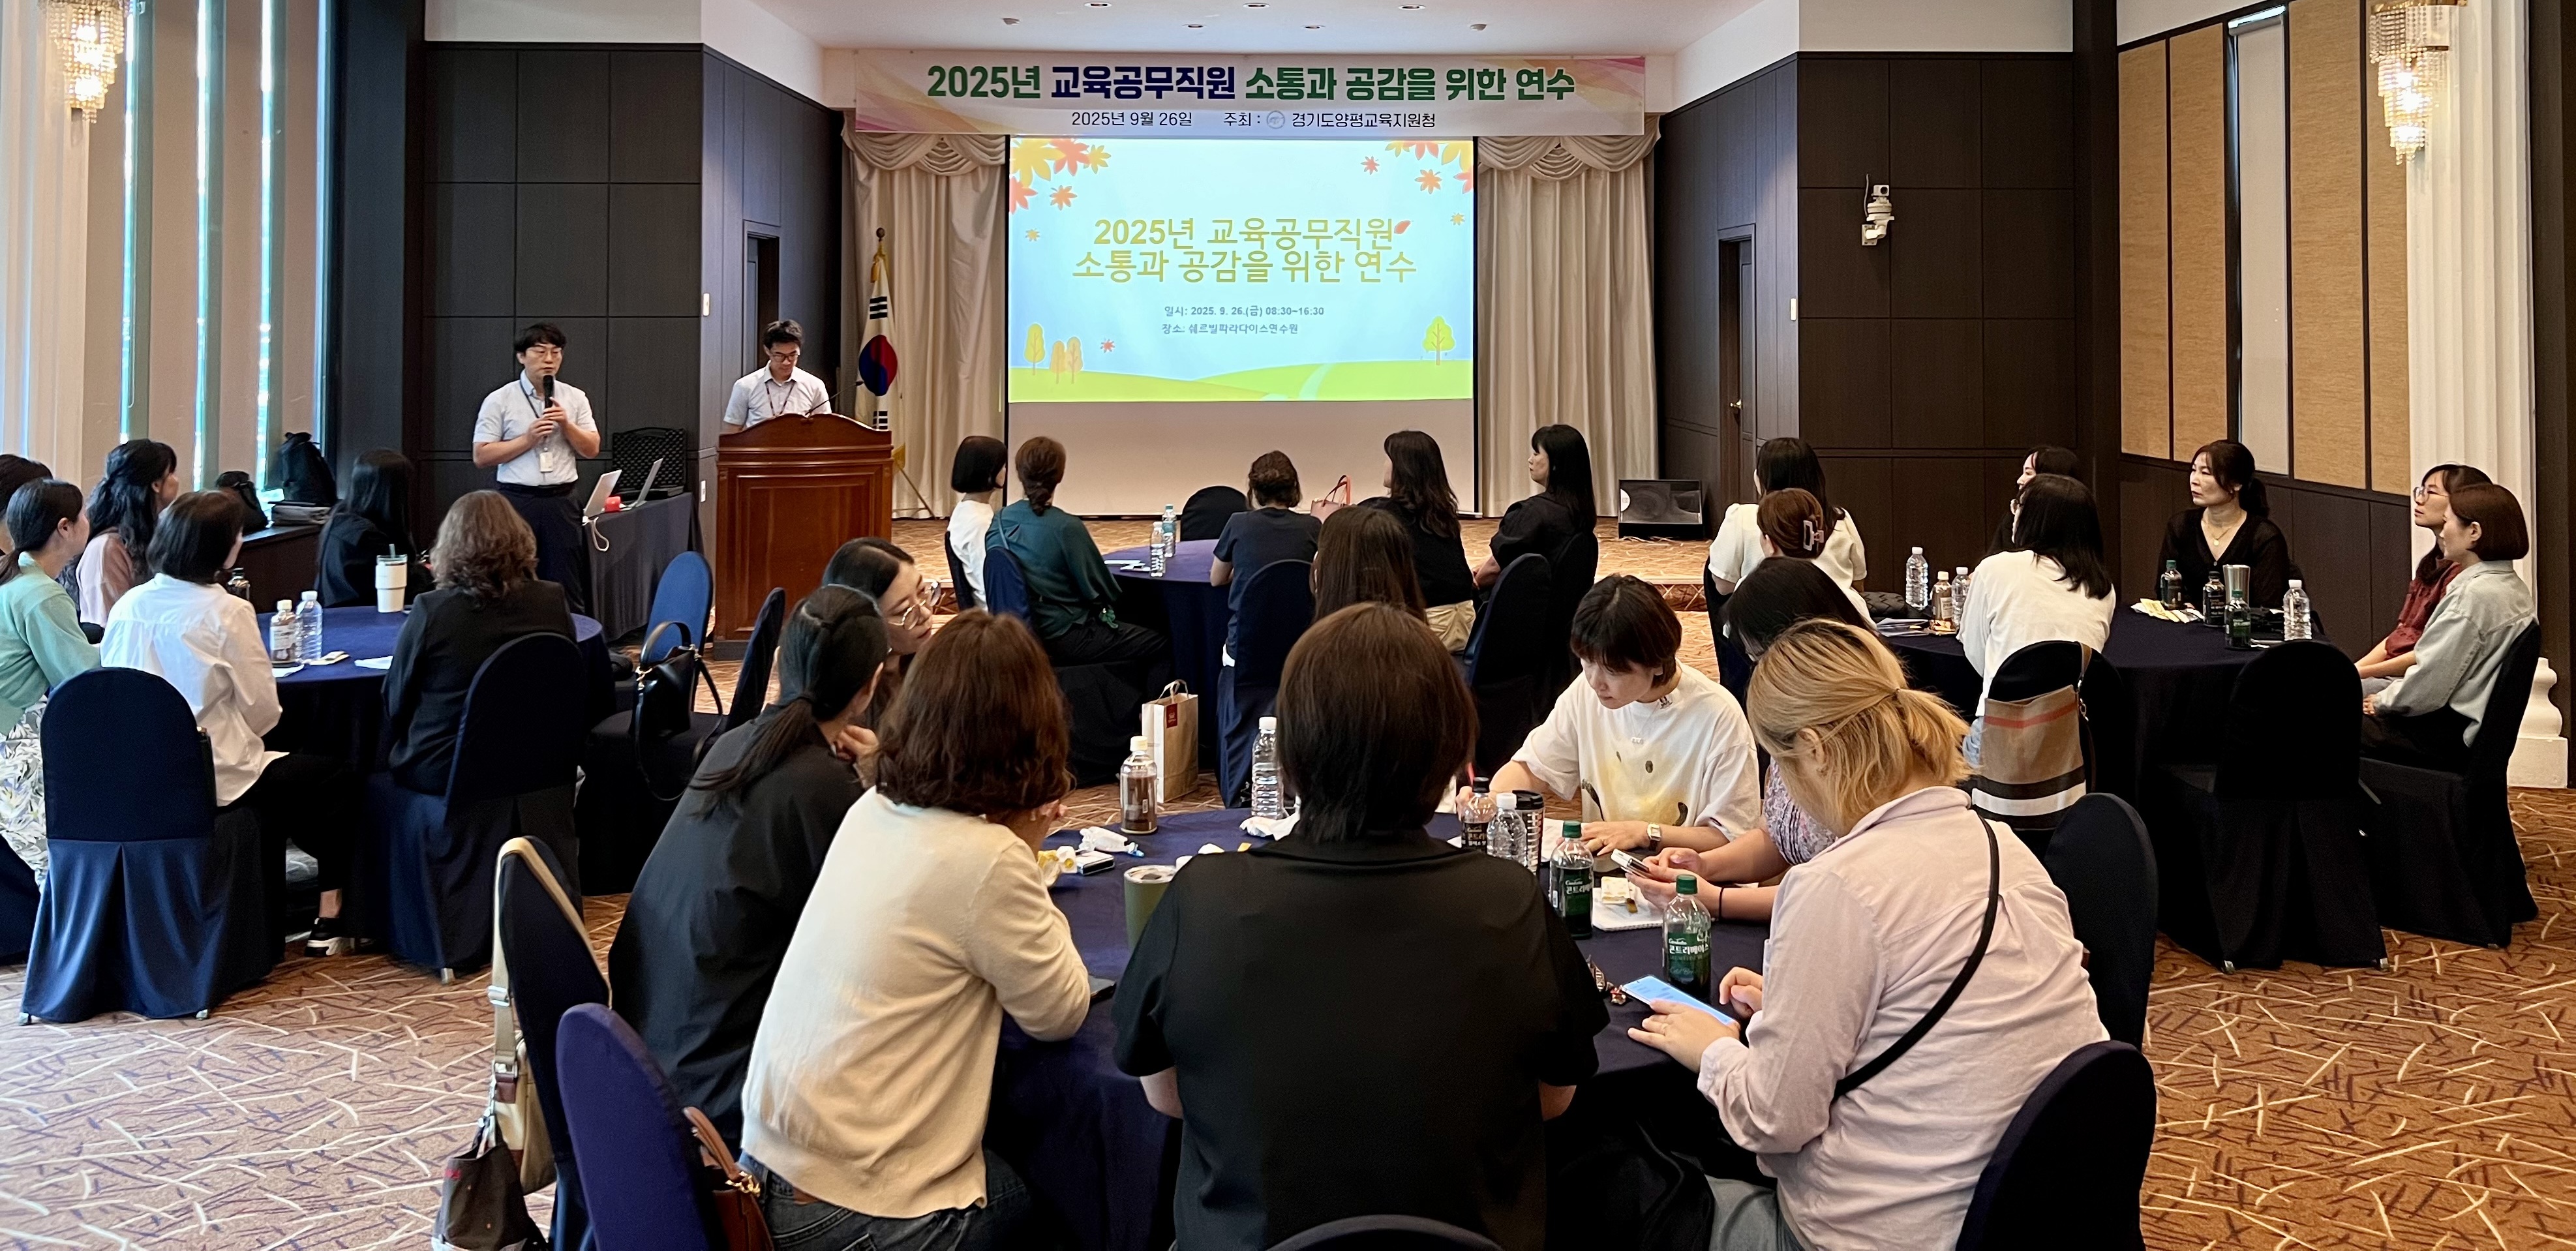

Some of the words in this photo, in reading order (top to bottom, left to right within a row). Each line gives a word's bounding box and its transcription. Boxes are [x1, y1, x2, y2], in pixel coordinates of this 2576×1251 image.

[928, 66, 1040, 98] 2025년
[1052, 67, 1235, 99] 교육공무직원
[1246, 67, 1337, 100] 소통과
[1346, 68, 1435, 100] 공감을
[1446, 68, 1506, 100] 위한
[1517, 69, 1574, 100] 연수
[1072, 112, 1124, 125] 2025년
[1130, 112, 1153, 126] 9월
[1159, 112, 1191, 126] 26일
[1224, 113, 1250, 126] 주최
[1293, 113, 1434, 127] 경기도양평교육지원청
[1094, 217, 1194, 249] 2025년
[1207, 217, 1393, 250] 교육공무직원
[1072, 250, 1170, 282] 소통과
[1178, 250, 1273, 282] 공감을
[1282, 250, 1345, 282] 위한
[1354, 250, 1417, 282] 연수
[1165, 307, 1187, 316] 일시:
[1190, 307, 1217, 315] 2025.
[1162, 324, 1185, 334] 장소:
